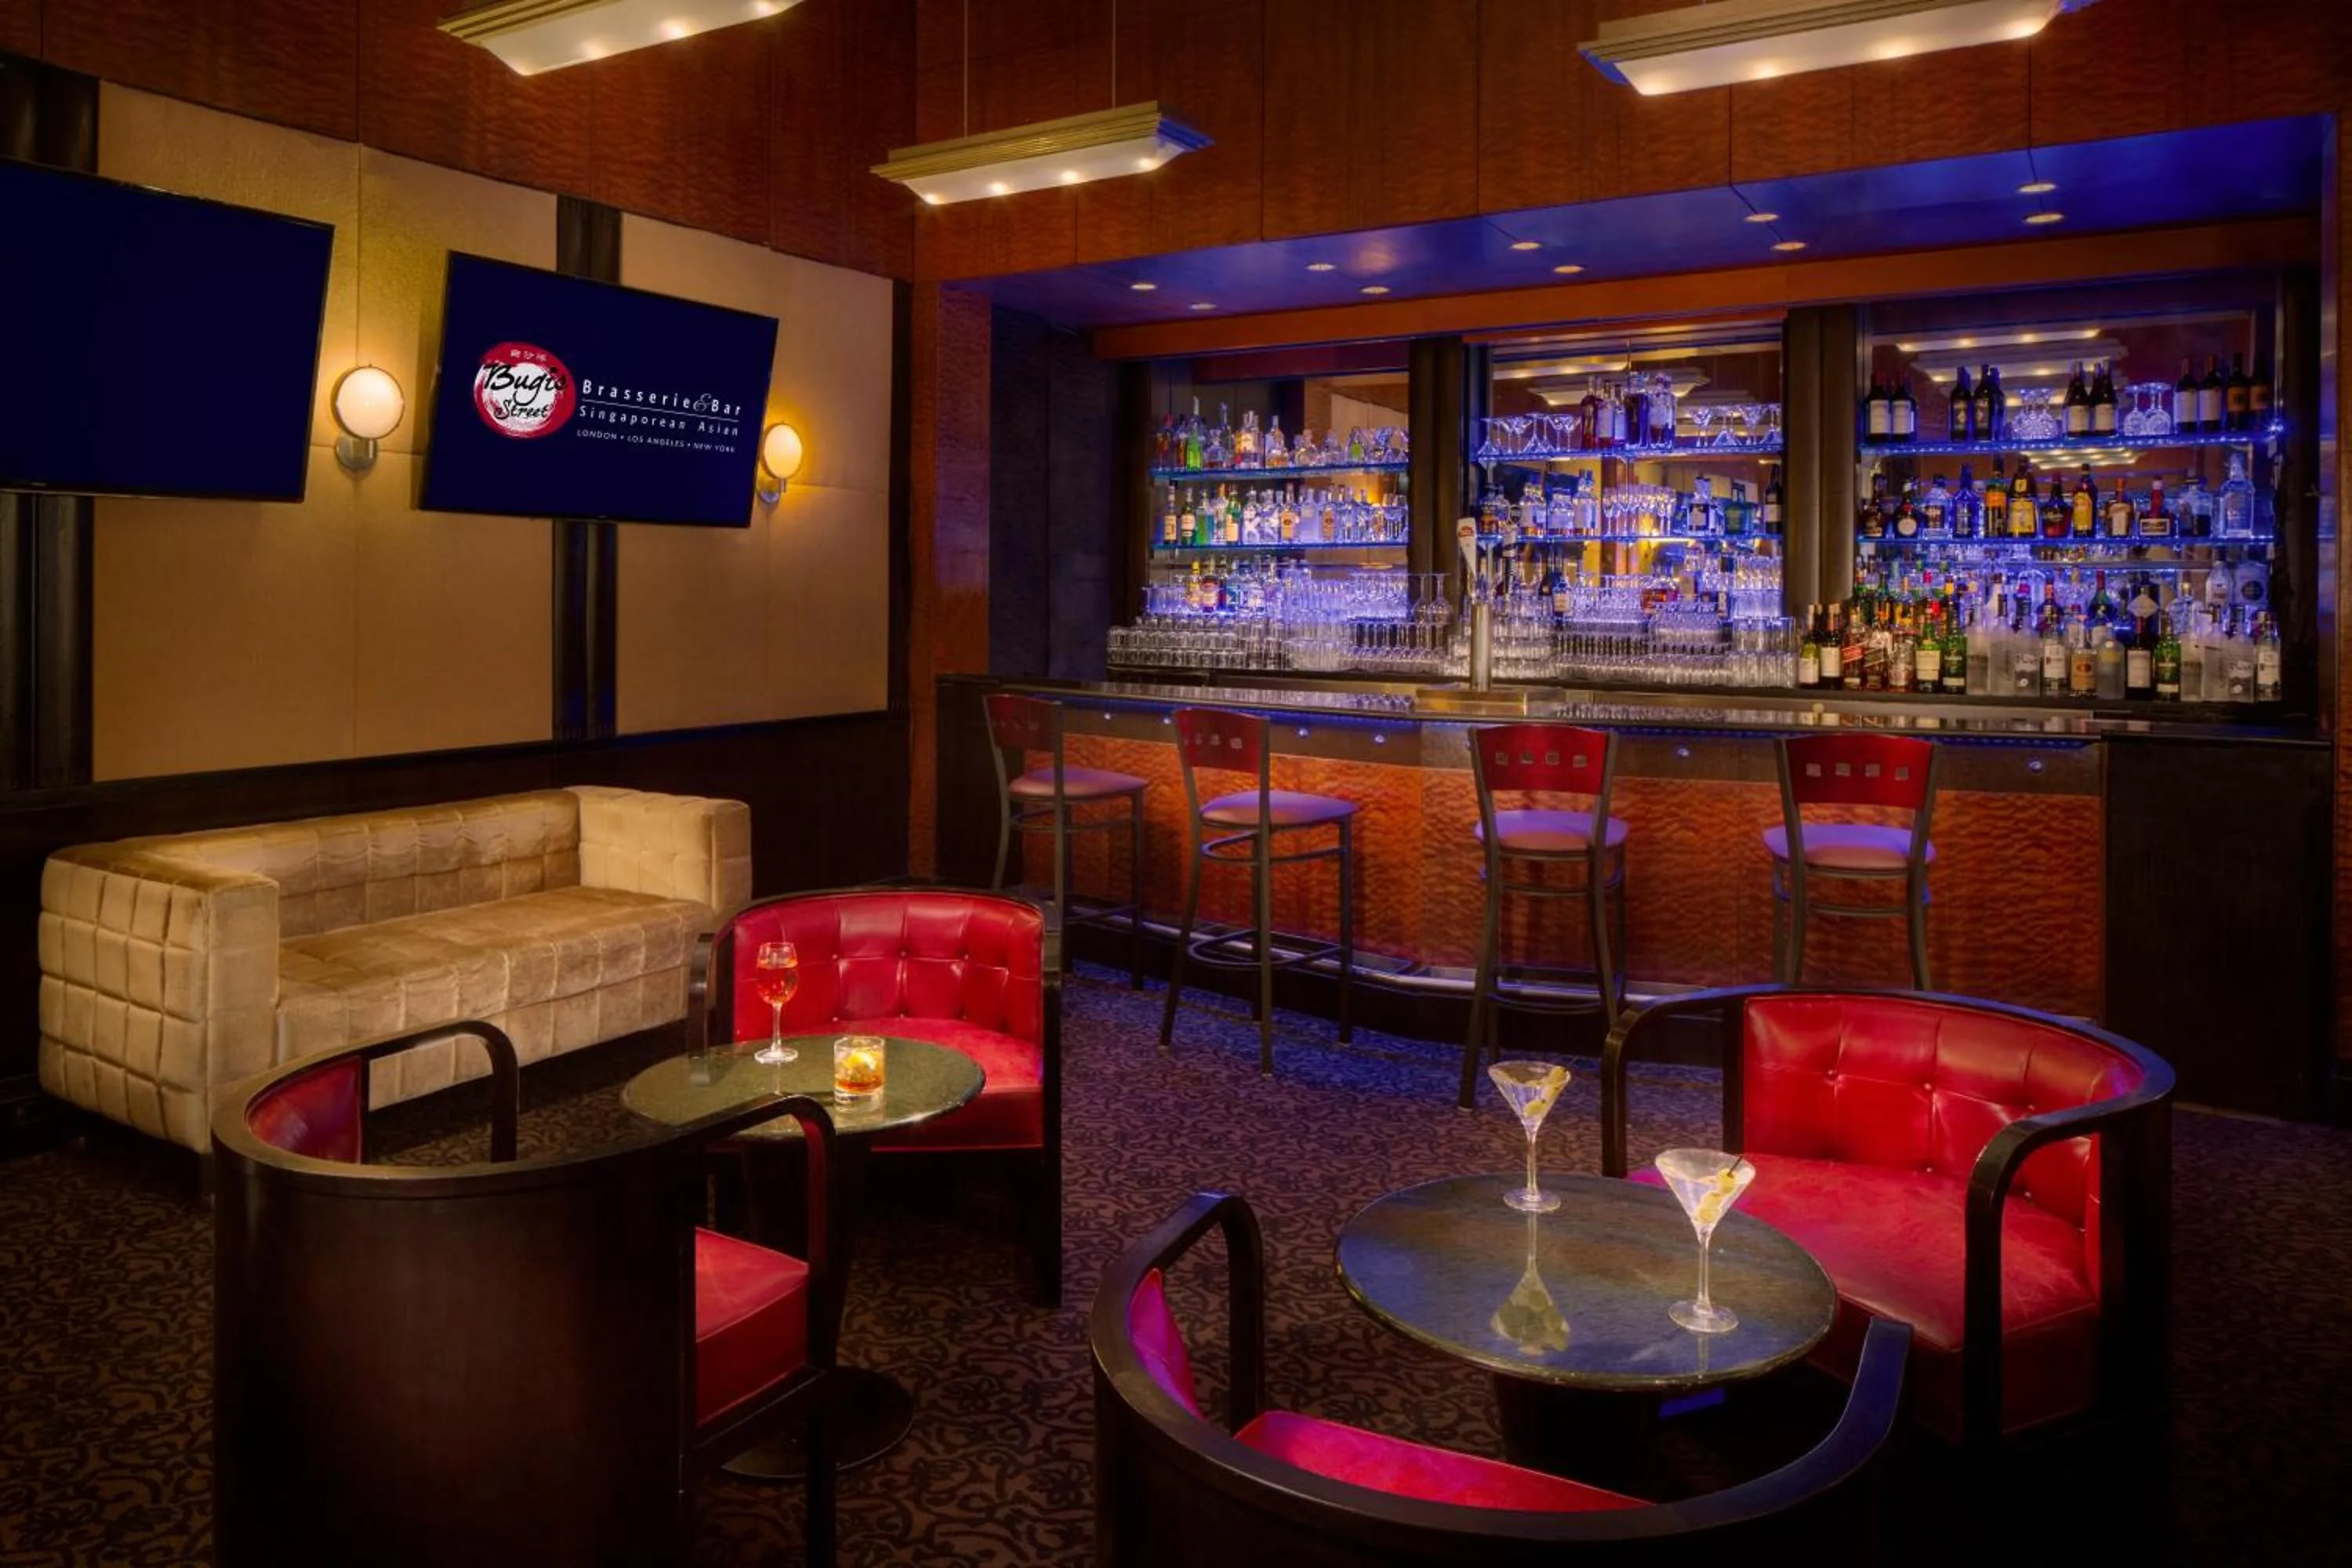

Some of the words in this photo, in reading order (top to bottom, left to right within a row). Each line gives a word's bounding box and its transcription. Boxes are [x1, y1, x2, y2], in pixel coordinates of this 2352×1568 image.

[494, 399, 552, 419] Street
[583, 379, 690, 408] Brasserie
[711, 399, 741, 415] Bar
[579, 405, 686, 430] Singaporean
[576, 429, 617, 440] LONDON
[646, 437, 684, 448] ANGELES
[693, 442, 712, 451] NEW
[714, 445, 735, 453] YORK
